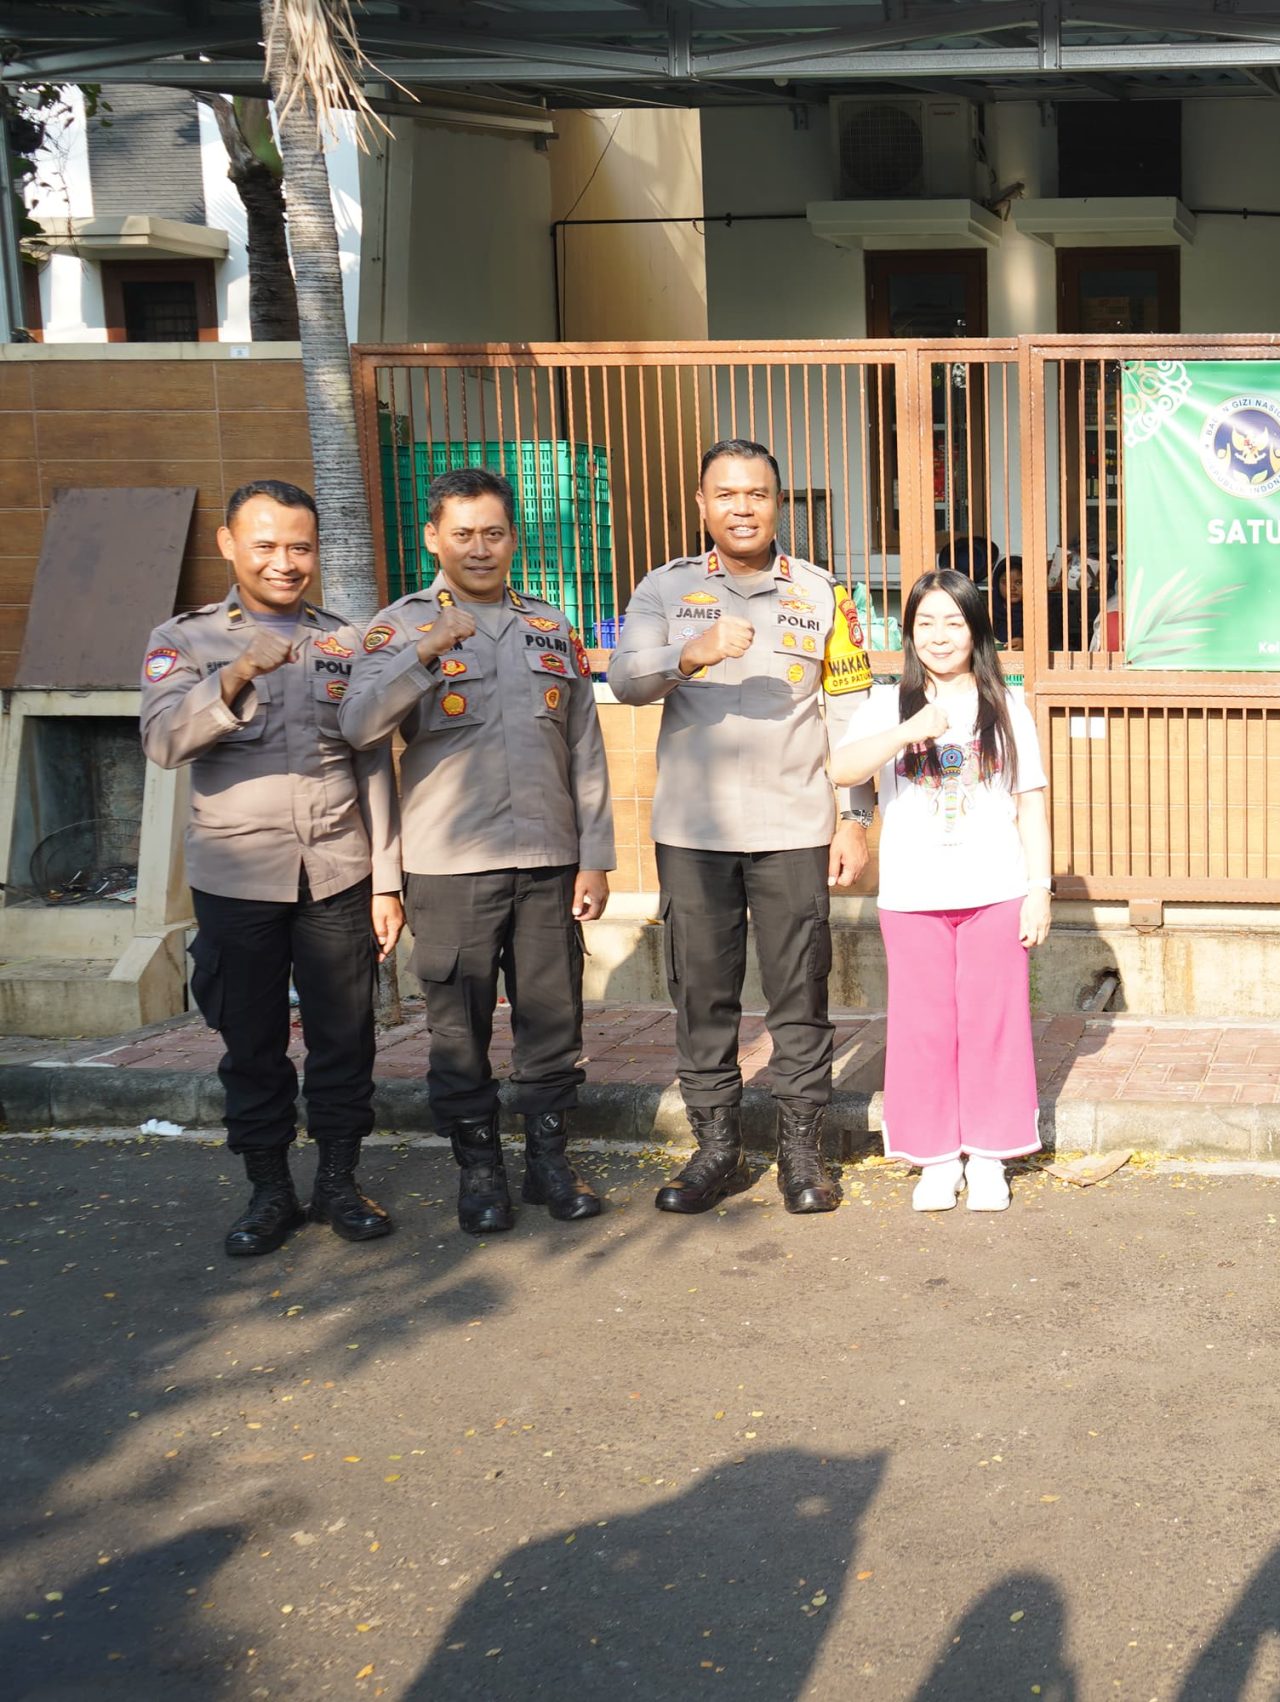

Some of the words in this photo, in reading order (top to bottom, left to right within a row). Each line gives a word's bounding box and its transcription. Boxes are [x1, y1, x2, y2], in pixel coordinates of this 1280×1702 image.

[1231, 398, 1252, 409] GIZI
[676, 607, 722, 620] JAMES
[777, 614, 820, 632] POLRI
[525, 634, 567, 653] POLRI
